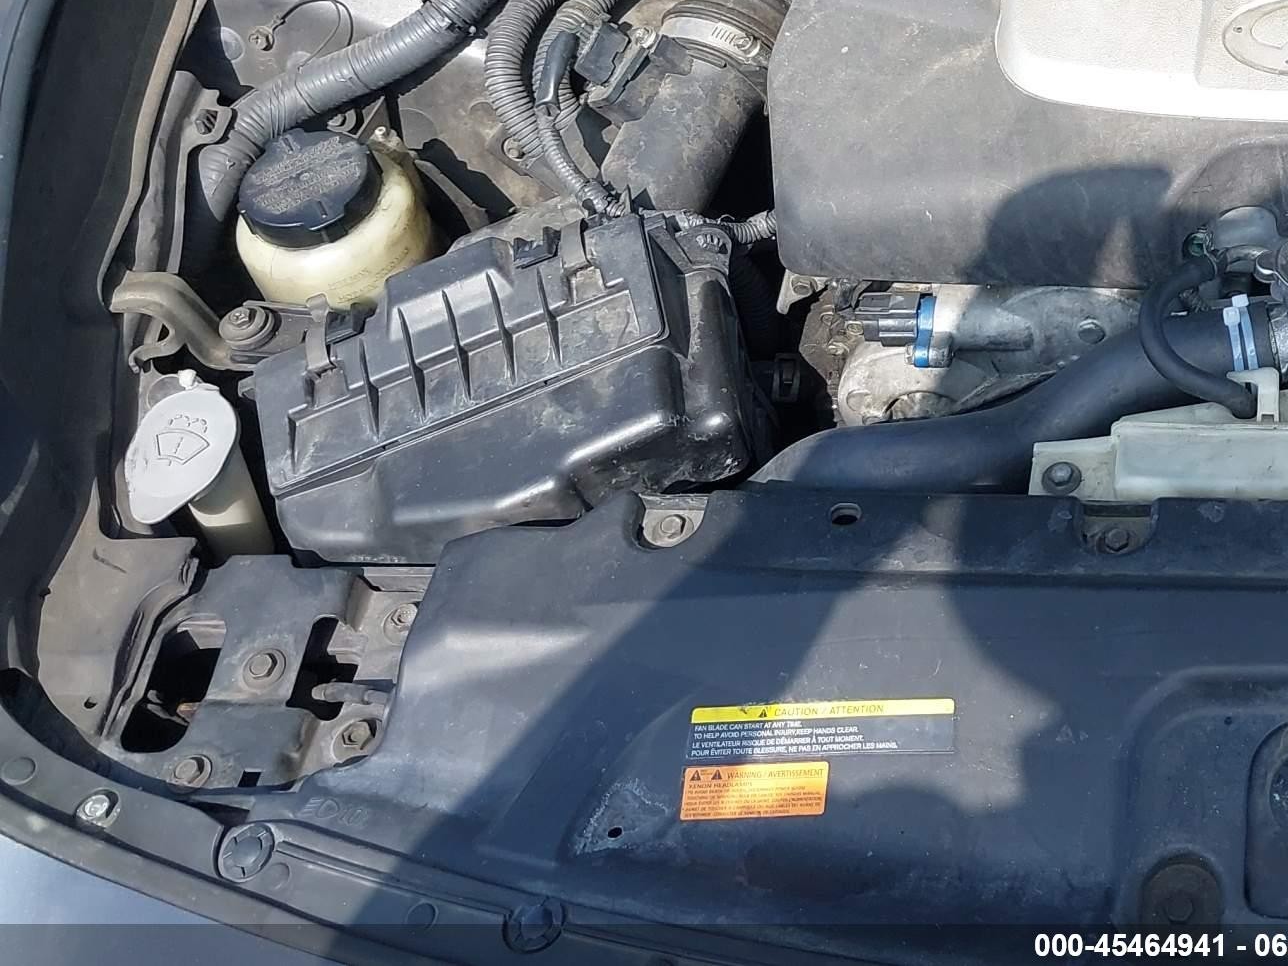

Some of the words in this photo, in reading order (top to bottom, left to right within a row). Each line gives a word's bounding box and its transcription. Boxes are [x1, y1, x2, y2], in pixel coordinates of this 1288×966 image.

[775, 707, 818, 716] CAUTION
[830, 704, 884, 715] ATTENTION
[695, 724, 707, 732] FAN
[708, 723, 728, 731] BLADE
[744, 722, 763, 730] START
[764, 721, 772, 729] AT
[720, 731, 739, 739] AVOID
[701, 740, 741, 748] VENTILATEUR
[742, 738, 766, 747] RISQUE
[818, 736, 834, 744] TOUT
[692, 749, 709, 757] POUR
[733, 747, 753, 755] TOUTE
[789, 745, 799, 753] NE
[812, 744, 821, 752] EN
[822, 742, 862, 751] APPROCHER
[728, 770, 762, 780] WARNING
[768, 768, 824, 778] AVERTISSEMENT
